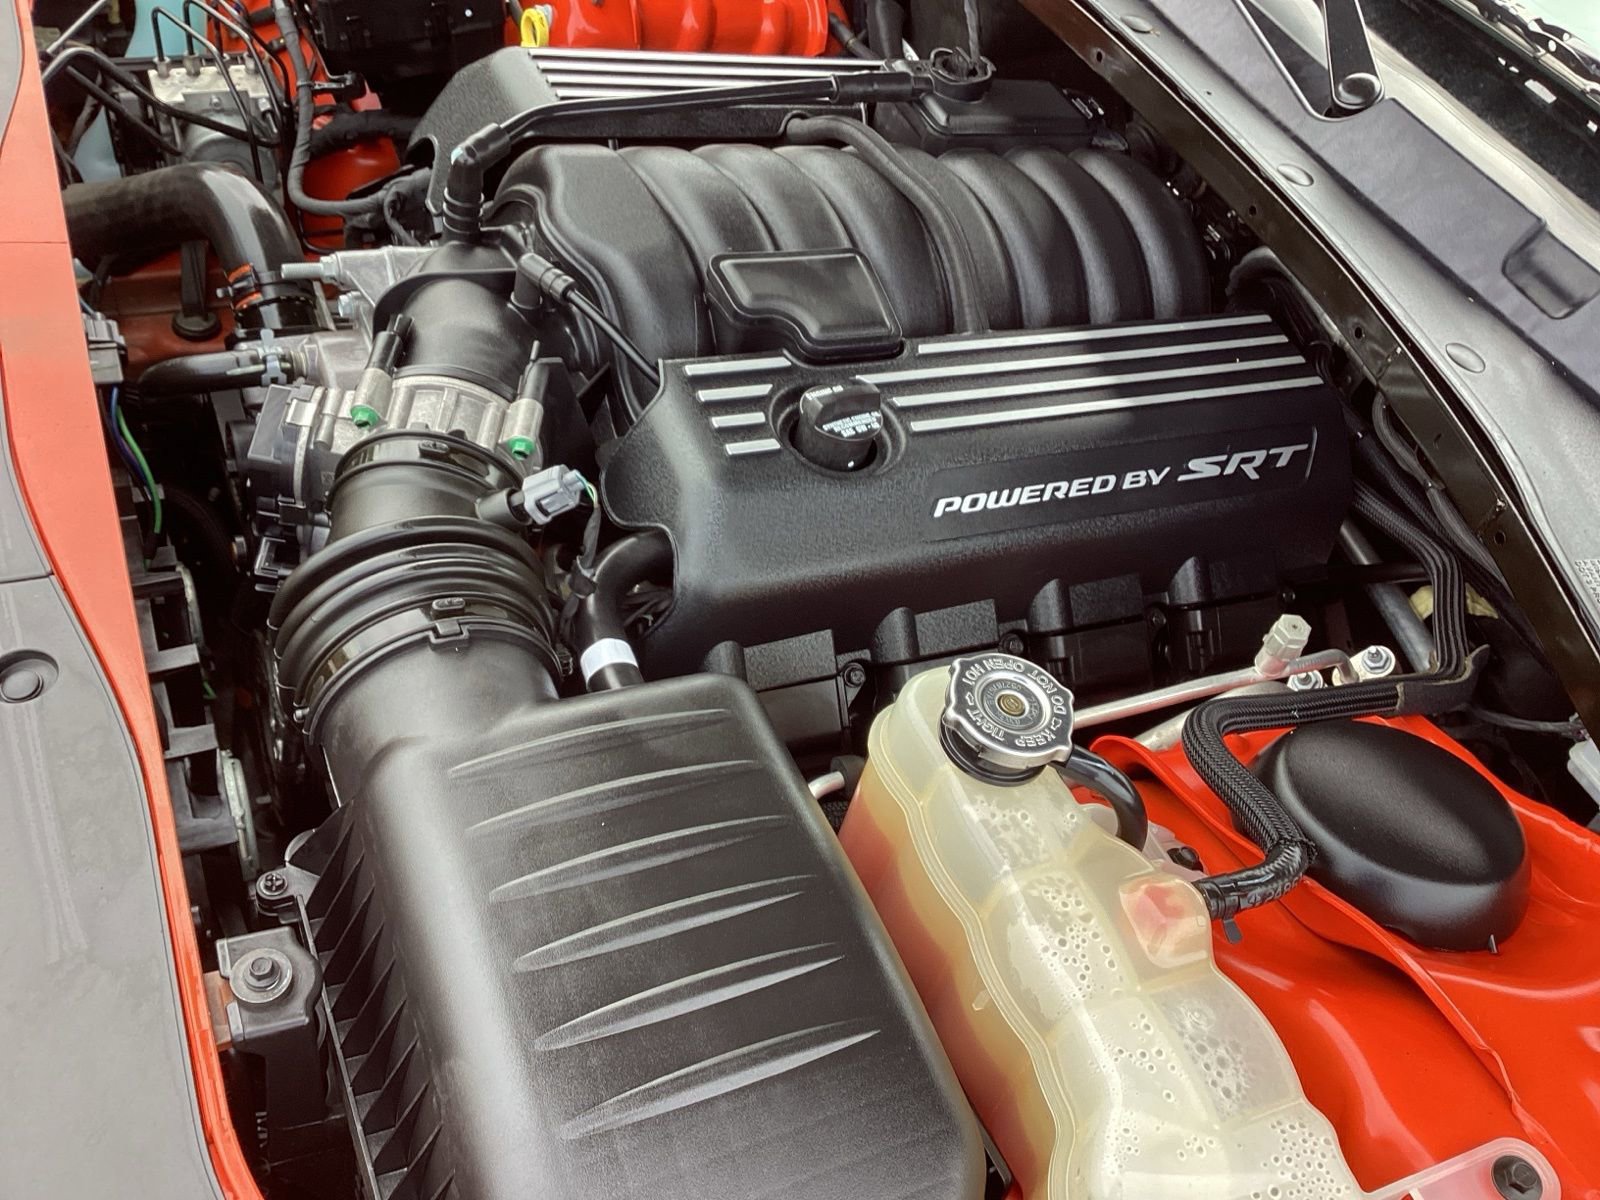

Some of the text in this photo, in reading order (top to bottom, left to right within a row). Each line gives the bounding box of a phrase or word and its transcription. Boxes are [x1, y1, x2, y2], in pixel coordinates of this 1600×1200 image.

[933, 443, 1309, 518] POWERED BY SRT
[962, 663, 986, 686] HOT
[983, 658, 1025, 673] OPEN
[1027, 670, 1058, 694] NOT
[1051, 696, 1067, 715] DO
[966, 708, 1005, 741] TIGHT
[1014, 729, 1056, 747] KEEP
